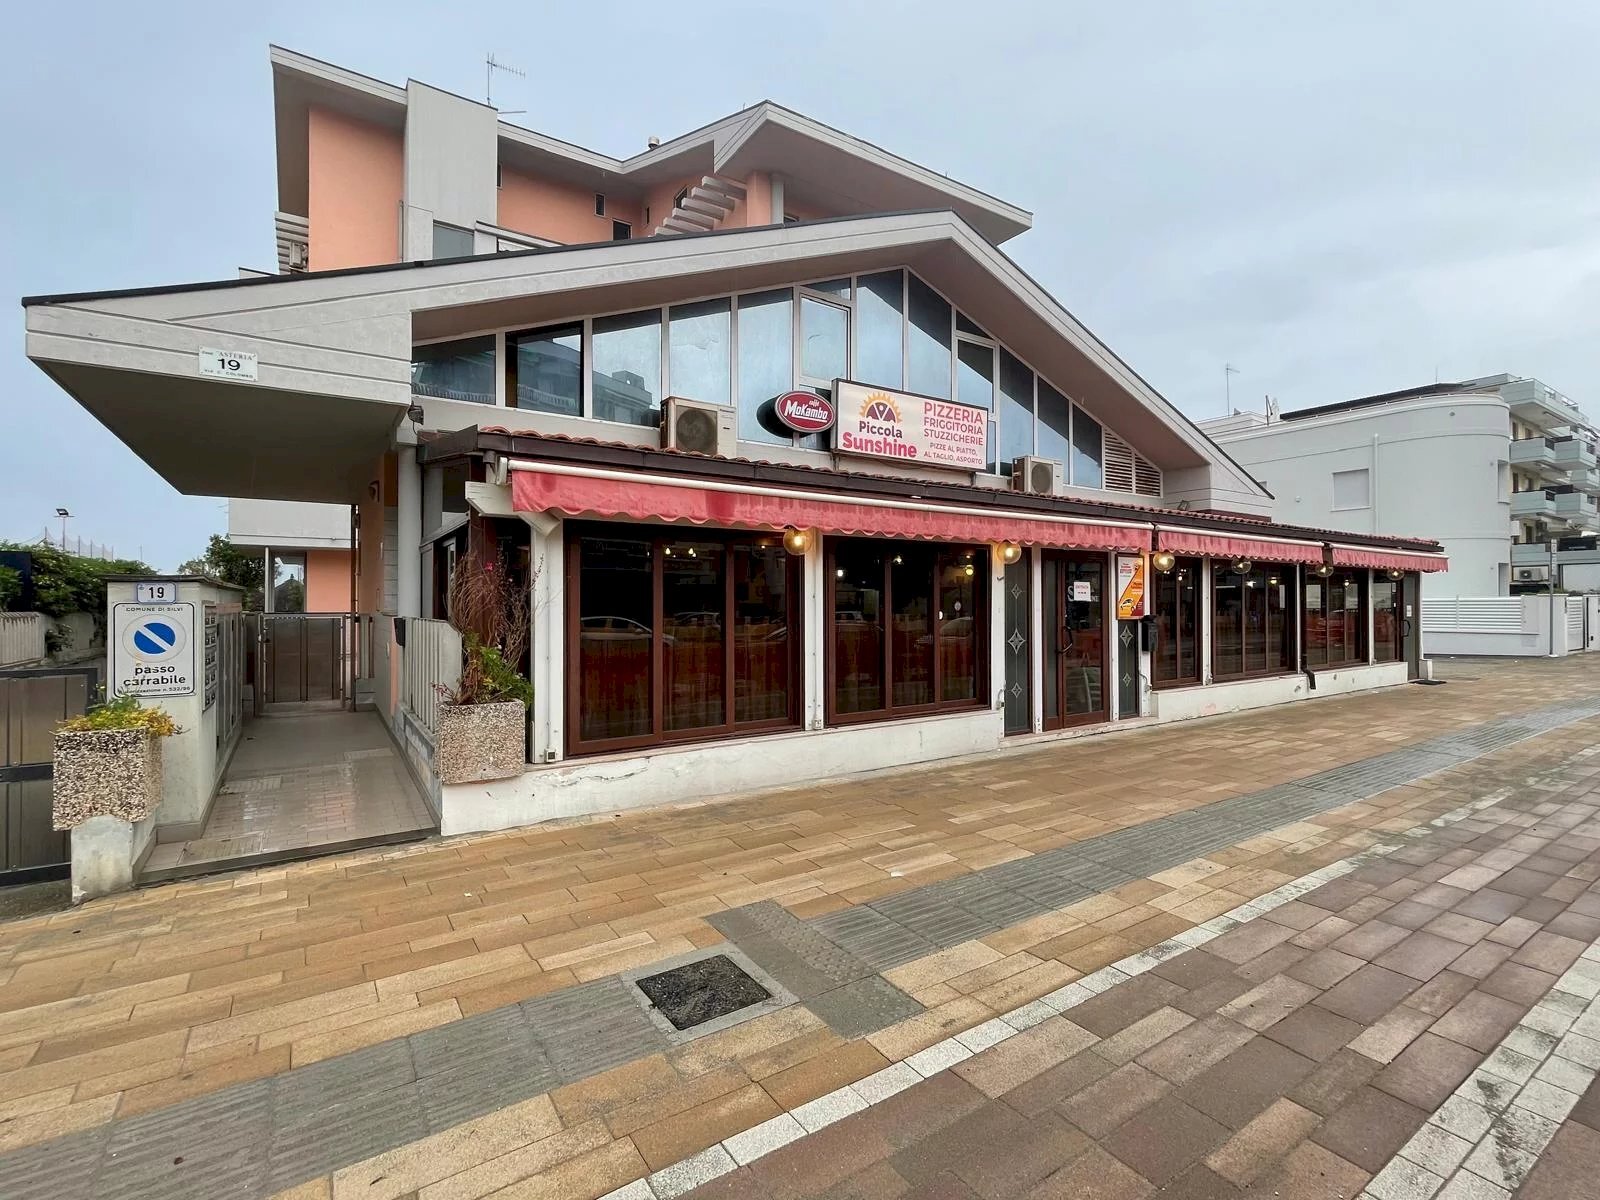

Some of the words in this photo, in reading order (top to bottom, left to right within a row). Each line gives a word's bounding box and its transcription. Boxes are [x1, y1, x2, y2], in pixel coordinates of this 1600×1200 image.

[217, 358, 241, 371] 19
[924, 402, 983, 425] PIZZERIA
[859, 420, 903, 439] Piccola
[923, 416, 983, 436] FRIGGITORIA
[923, 428, 984, 446] STUZZICHERIE
[842, 431, 918, 459] Sunshine
[930, 442, 947, 451] PIZZE
[947, 445, 955, 453] AL
[956, 446, 978, 457] PIATTO,
[932, 452, 956, 462] TAGLIO,
[956, 455, 983, 465] ASPORTO
[148, 586, 165, 599] 19
[134, 665, 176, 675] passo
[123, 675, 186, 687] carrabile
